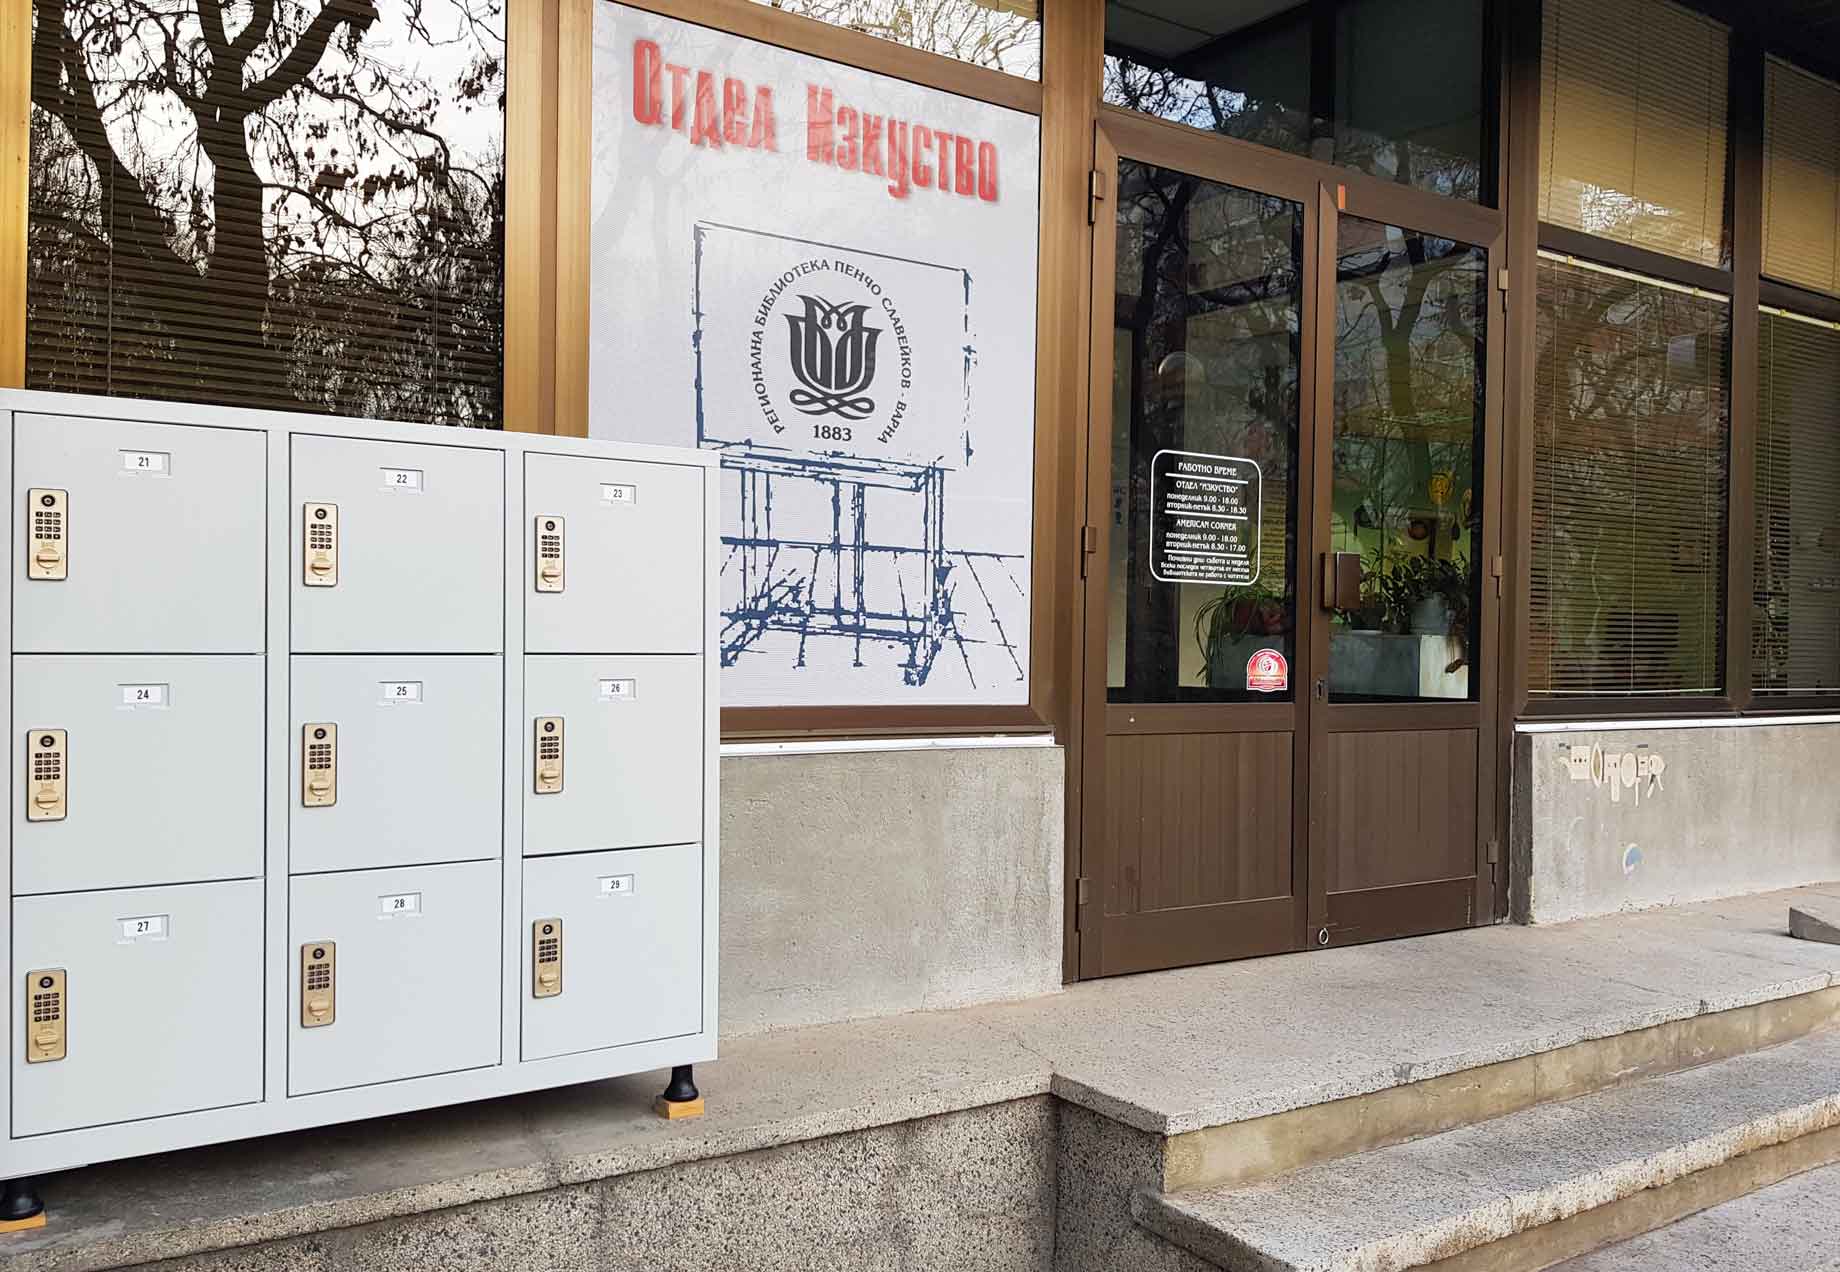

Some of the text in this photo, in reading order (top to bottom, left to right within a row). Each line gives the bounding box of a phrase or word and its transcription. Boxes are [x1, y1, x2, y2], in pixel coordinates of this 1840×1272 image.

[633, 40, 999, 202] Отдел Изкуство
[834, 260, 881, 296] ПЕНЧО
[755, 259, 830, 327] БИБЛИОТЕКА
[882, 297, 912, 389] СЛАВЕЙКОВ
[750, 328, 785, 434] РЕГИОНАЛНА
[877, 400, 907, 444] ВАРНА
[813, 424, 852, 442] 1883
[138, 457, 149, 467] 21
[1178, 462, 1237, 476] РАБОТНО ВРЕМЕ
[397, 473, 408, 484] 22
[1176, 480, 1198, 490] ОТДЕЛ
[613, 489, 623, 498] 23
[1203, 495, 1216, 503] 9.00
[1222, 496, 1238, 505] 18.00
[1176, 519, 1237, 532] AMERICAN CORNER
[1202, 533, 1216, 541] 9.00
[1229, 544, 1246, 552] 17.00
[397, 687, 408, 697] 25
[611, 683, 620, 694] 26
[137, 690, 149, 701] 24
[611, 879, 620, 890] 29
[394, 898, 406, 909] 28
[137, 921, 149, 933] 27
